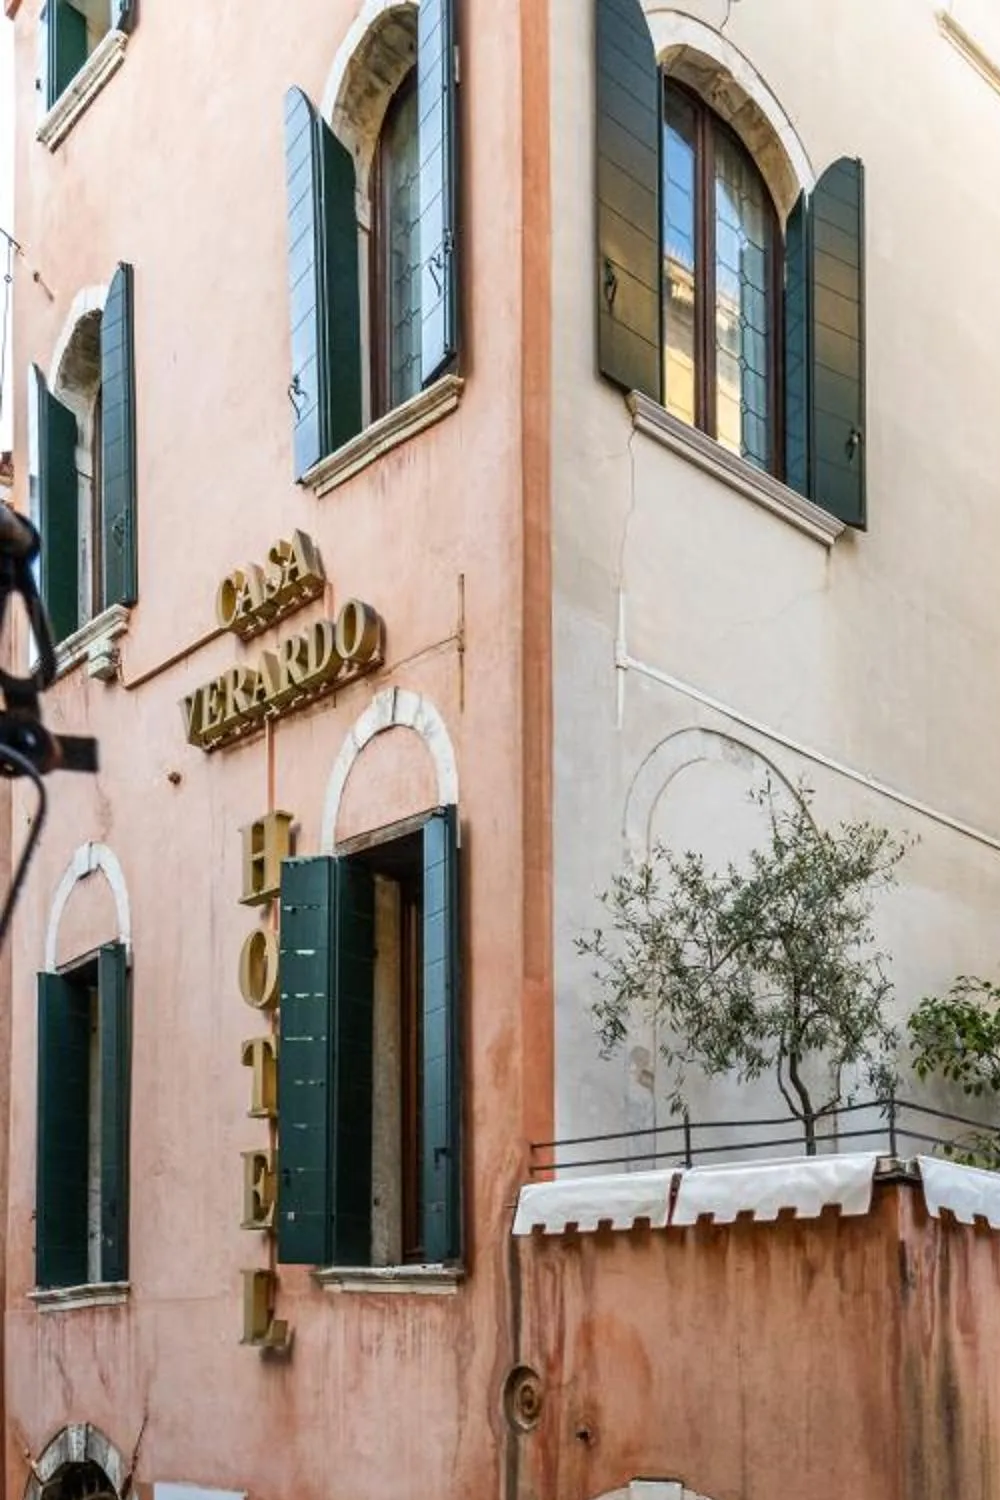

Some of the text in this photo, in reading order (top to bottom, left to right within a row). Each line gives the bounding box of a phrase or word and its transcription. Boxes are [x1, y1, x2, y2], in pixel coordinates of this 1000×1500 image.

[215, 528, 325, 634] CASA
[177, 597, 383, 750] VERARDO
[238, 809, 294, 1346] HOTEL
